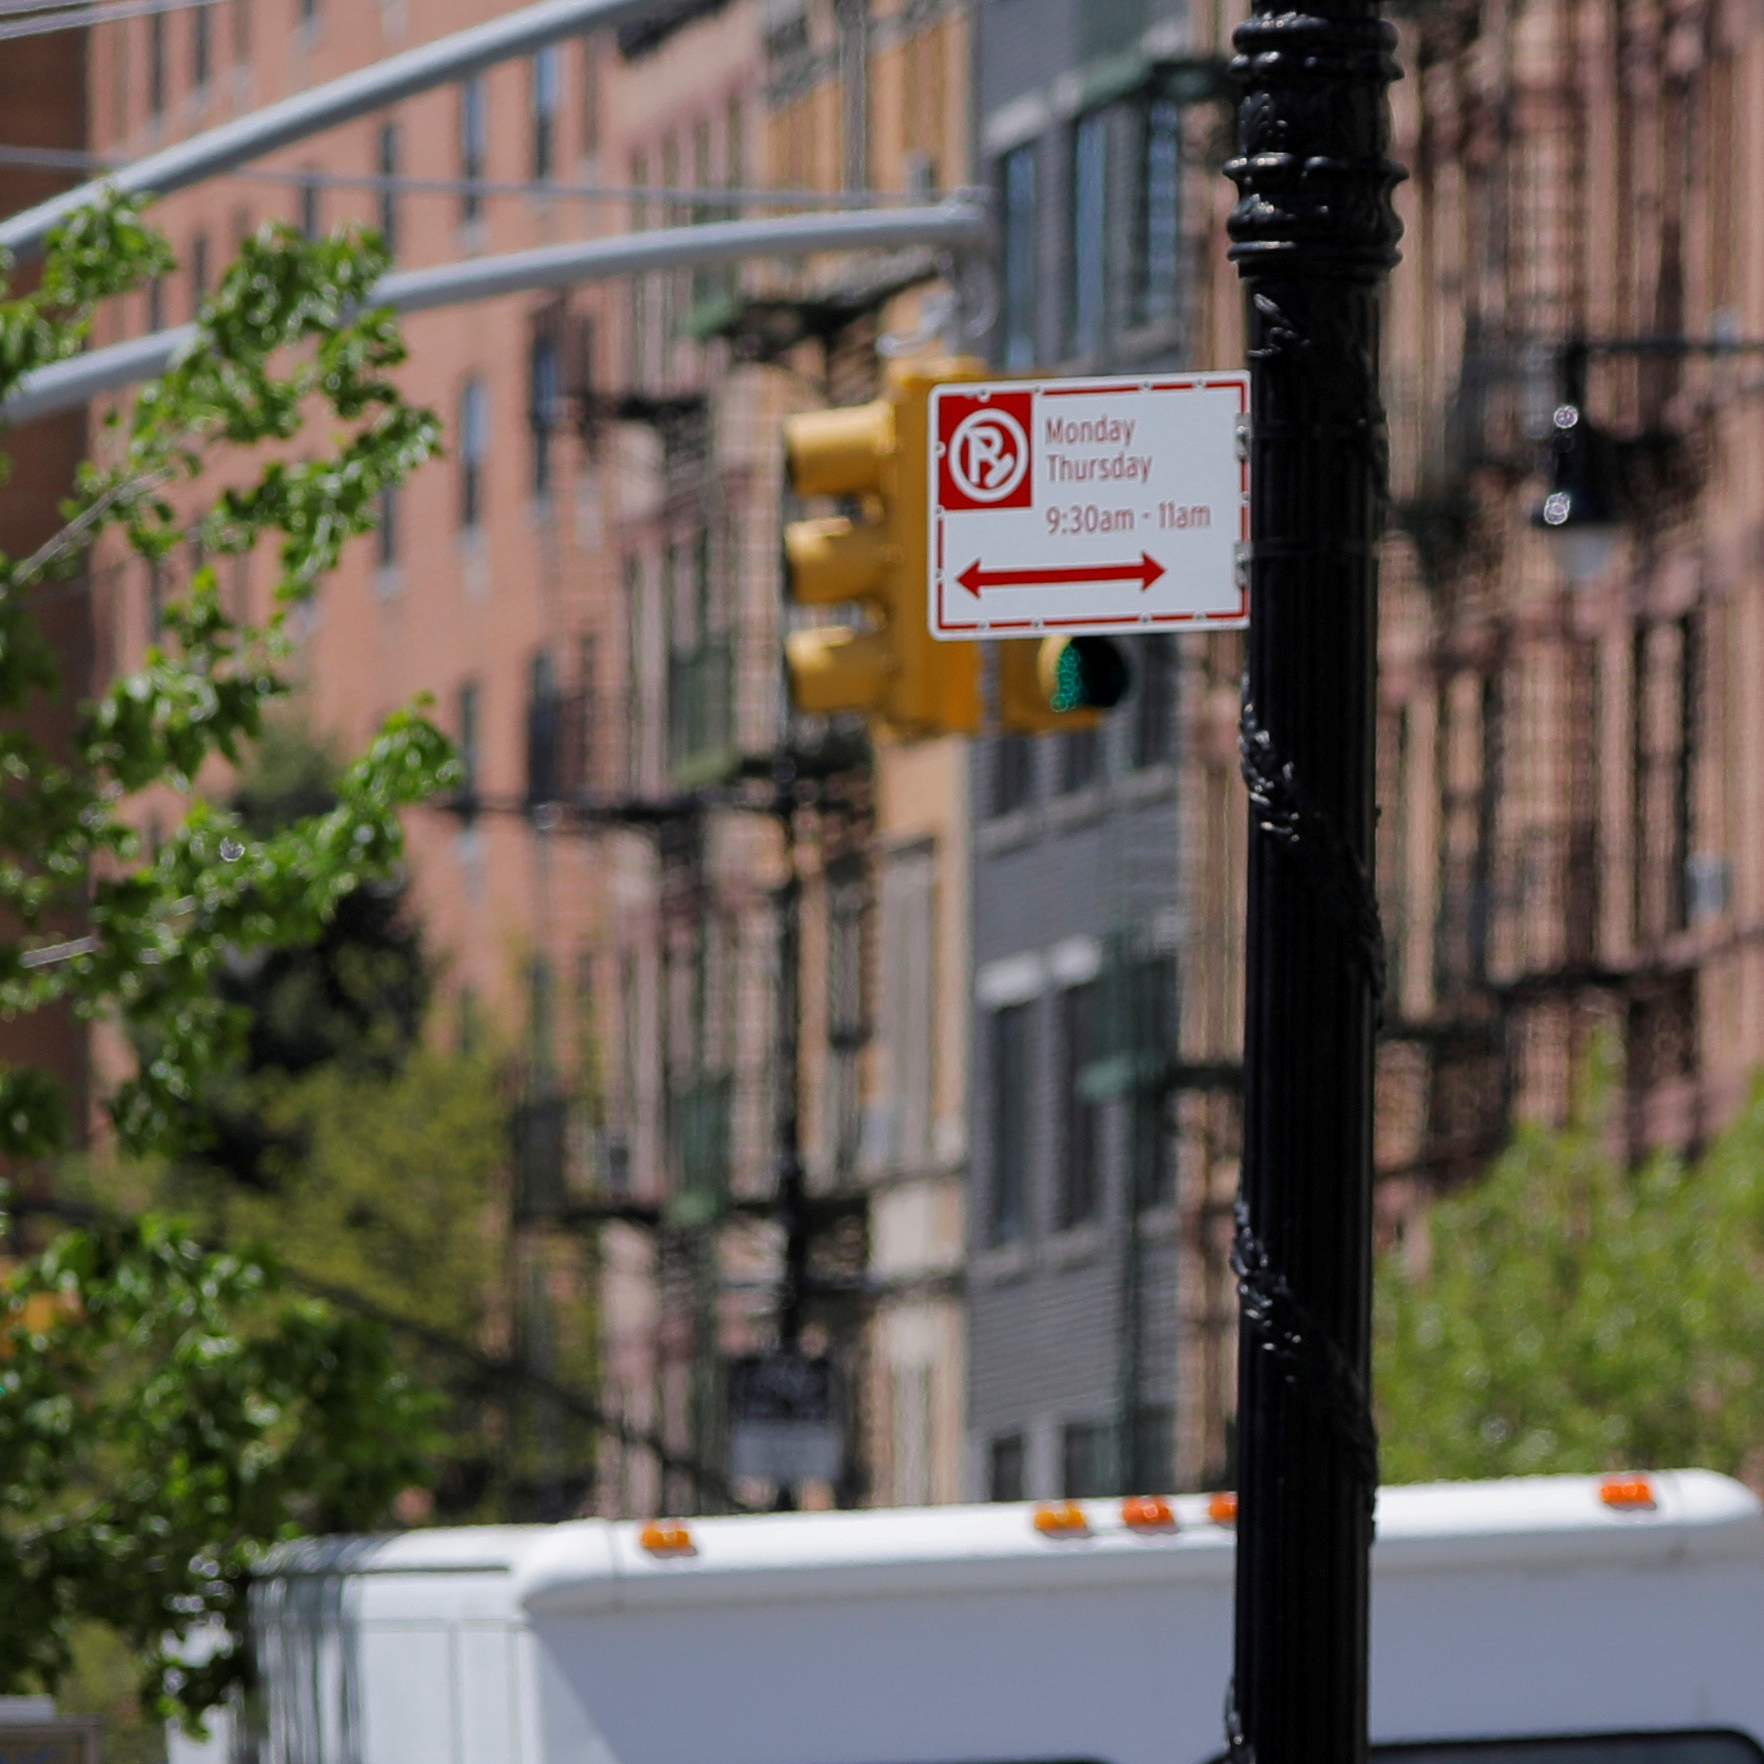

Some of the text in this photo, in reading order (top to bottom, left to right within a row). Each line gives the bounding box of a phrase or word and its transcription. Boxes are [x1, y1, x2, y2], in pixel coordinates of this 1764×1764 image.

[1045, 413, 1135, 446] Monday
[1047, 452, 1153, 483] Thursday
[1045, 504, 1135, 535] 9:30am
[1158, 501, 1211, 530] 11am
